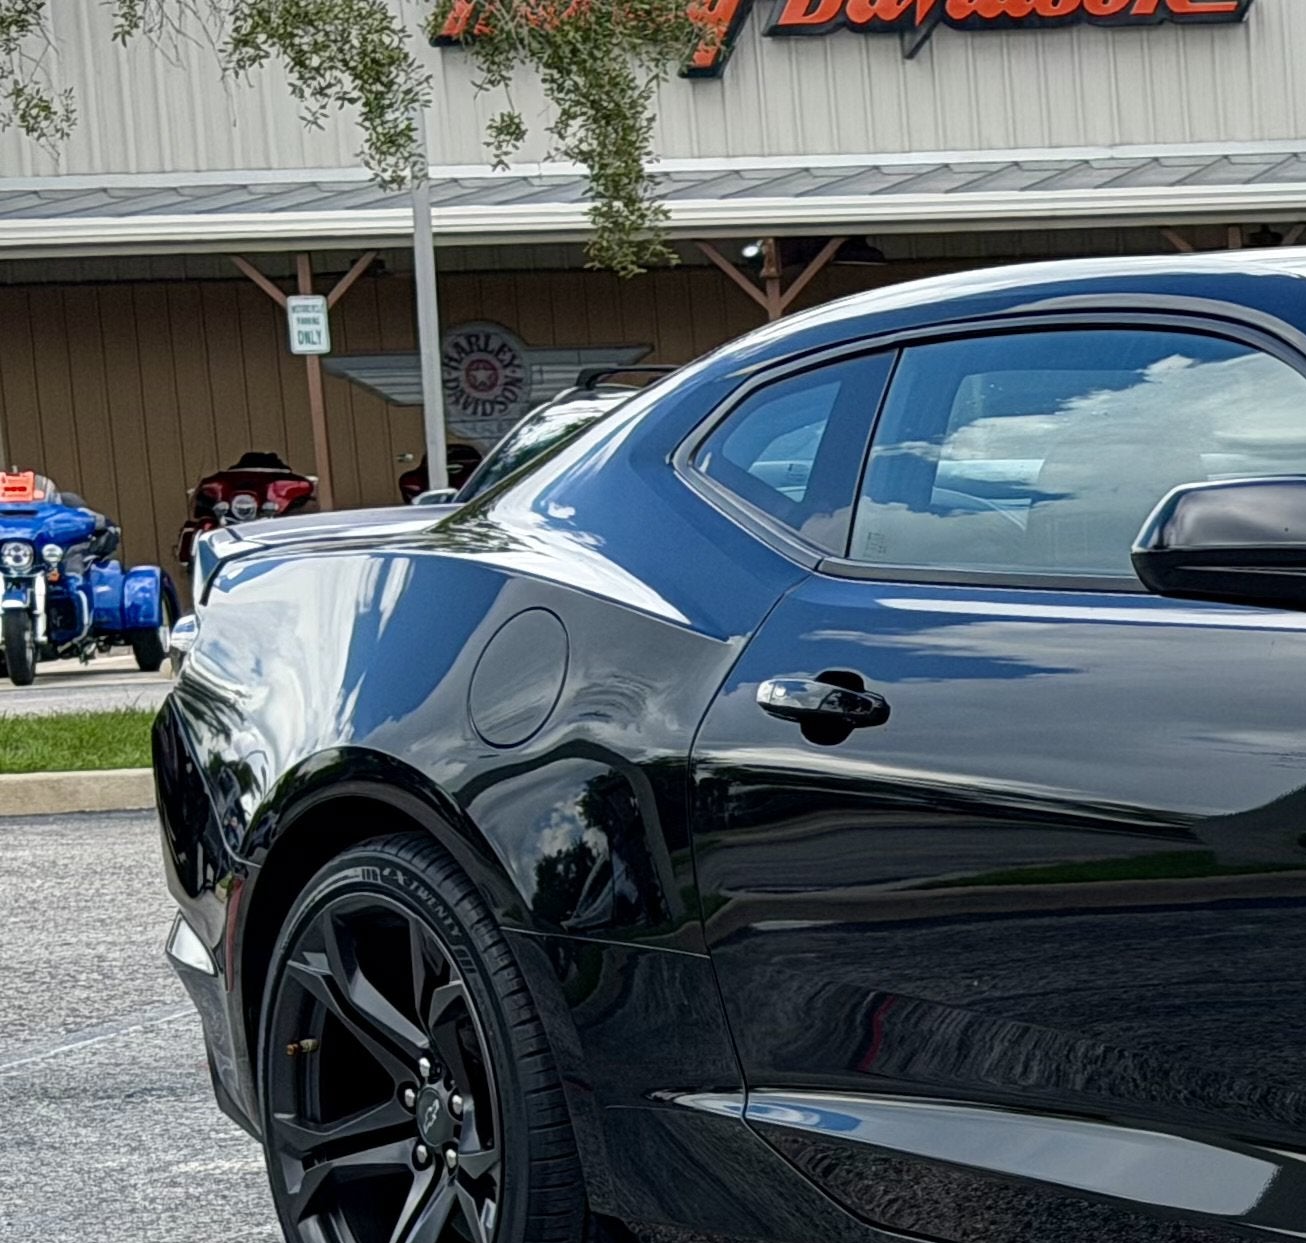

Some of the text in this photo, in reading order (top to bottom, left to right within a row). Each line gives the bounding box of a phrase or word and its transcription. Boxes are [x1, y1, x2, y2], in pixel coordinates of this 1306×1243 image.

[297, 329, 321, 345] ONLY
[442, 333, 522, 369] HARLEY
[442, 375, 524, 417] DAVIDSON
